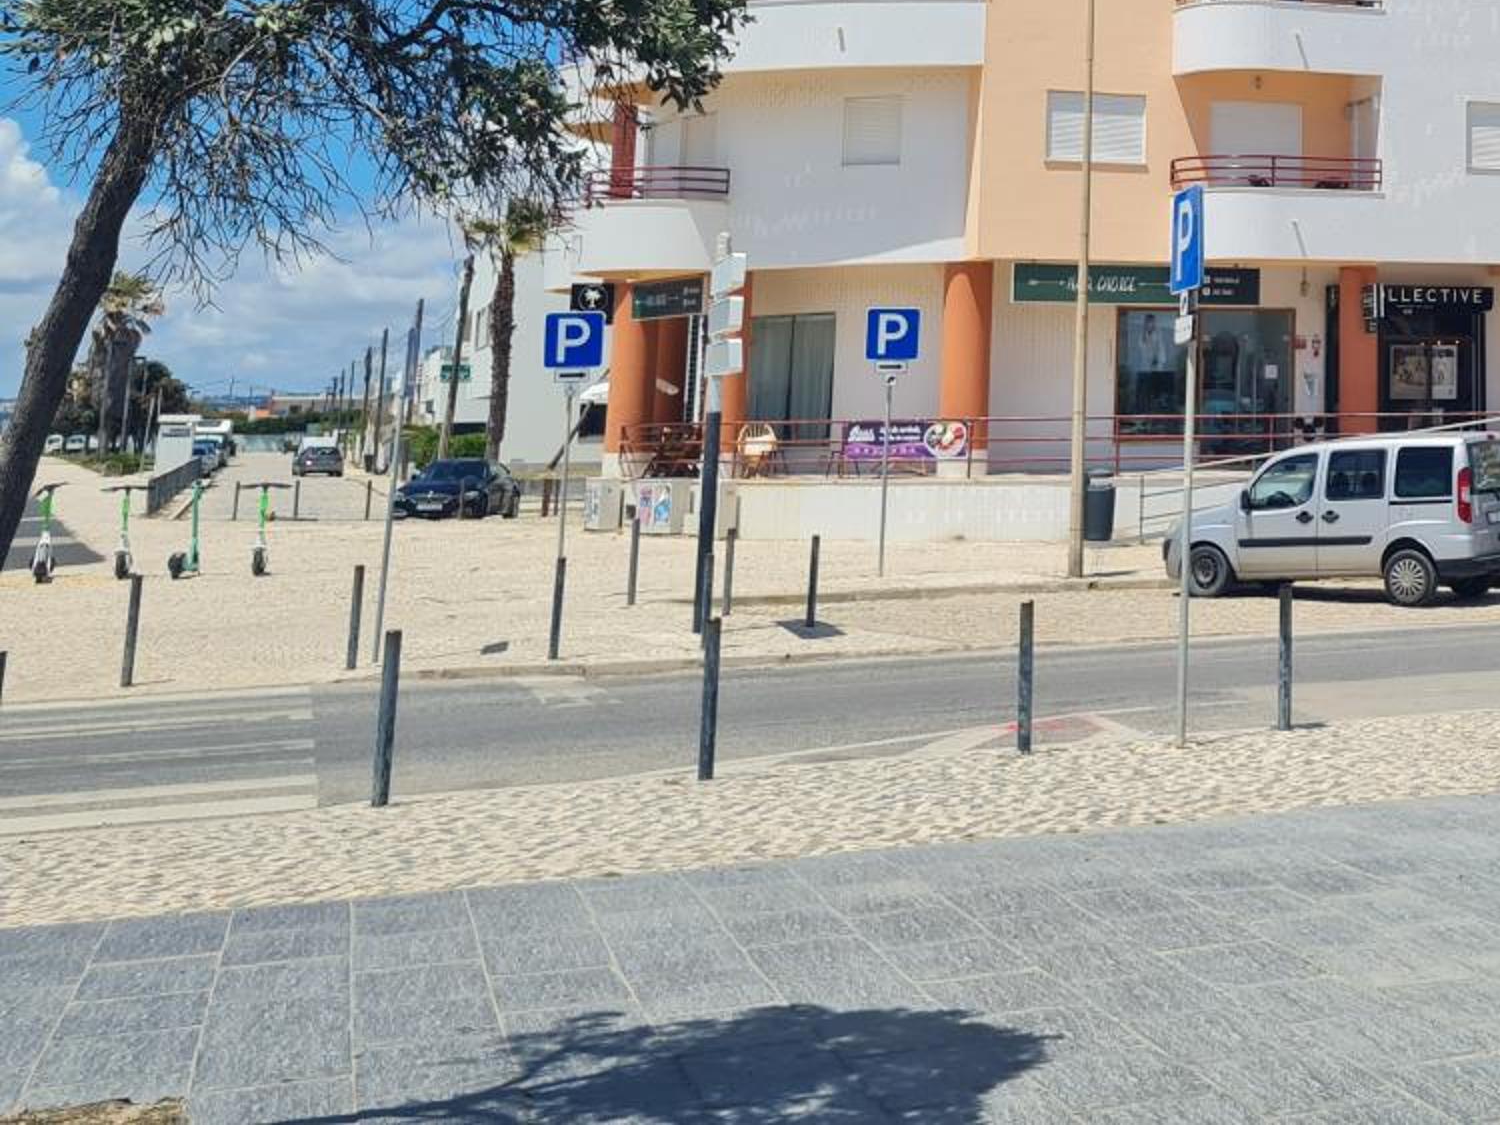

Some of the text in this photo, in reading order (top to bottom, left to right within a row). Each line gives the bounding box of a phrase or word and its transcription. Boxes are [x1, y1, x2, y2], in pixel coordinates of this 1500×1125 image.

[1177, 200, 1193, 282] P
[1388, 288, 1483, 304] LLECTIVE
[556, 318, 591, 363] P
[878, 313, 909, 355] P
